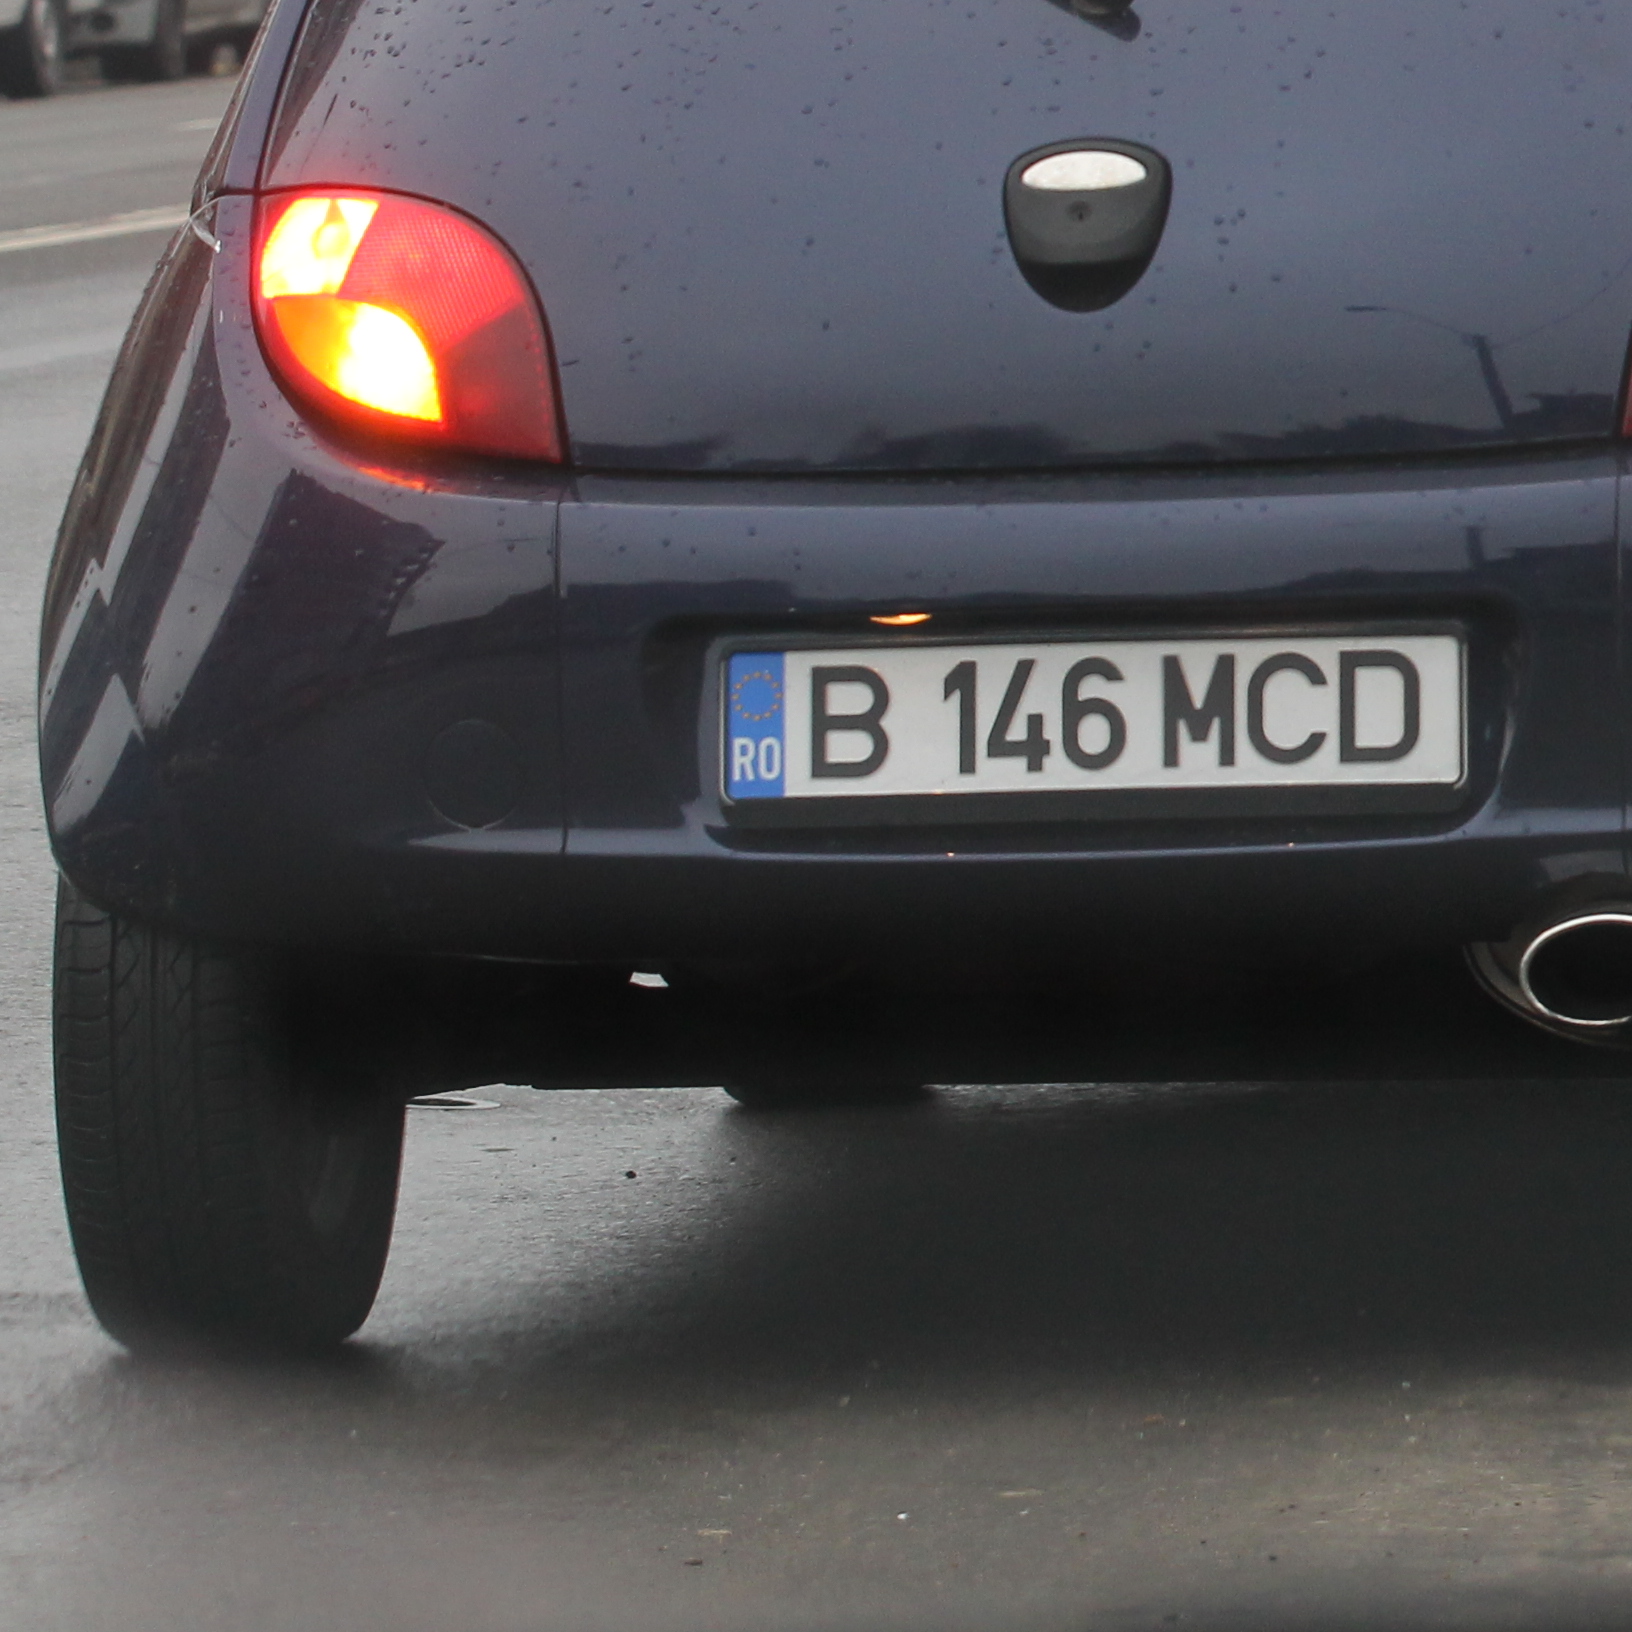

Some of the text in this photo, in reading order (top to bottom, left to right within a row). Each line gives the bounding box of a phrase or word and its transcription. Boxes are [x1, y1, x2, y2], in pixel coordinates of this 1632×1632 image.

[811, 649, 1421, 780] B 146 MCD
[732, 736, 783, 783] RO
